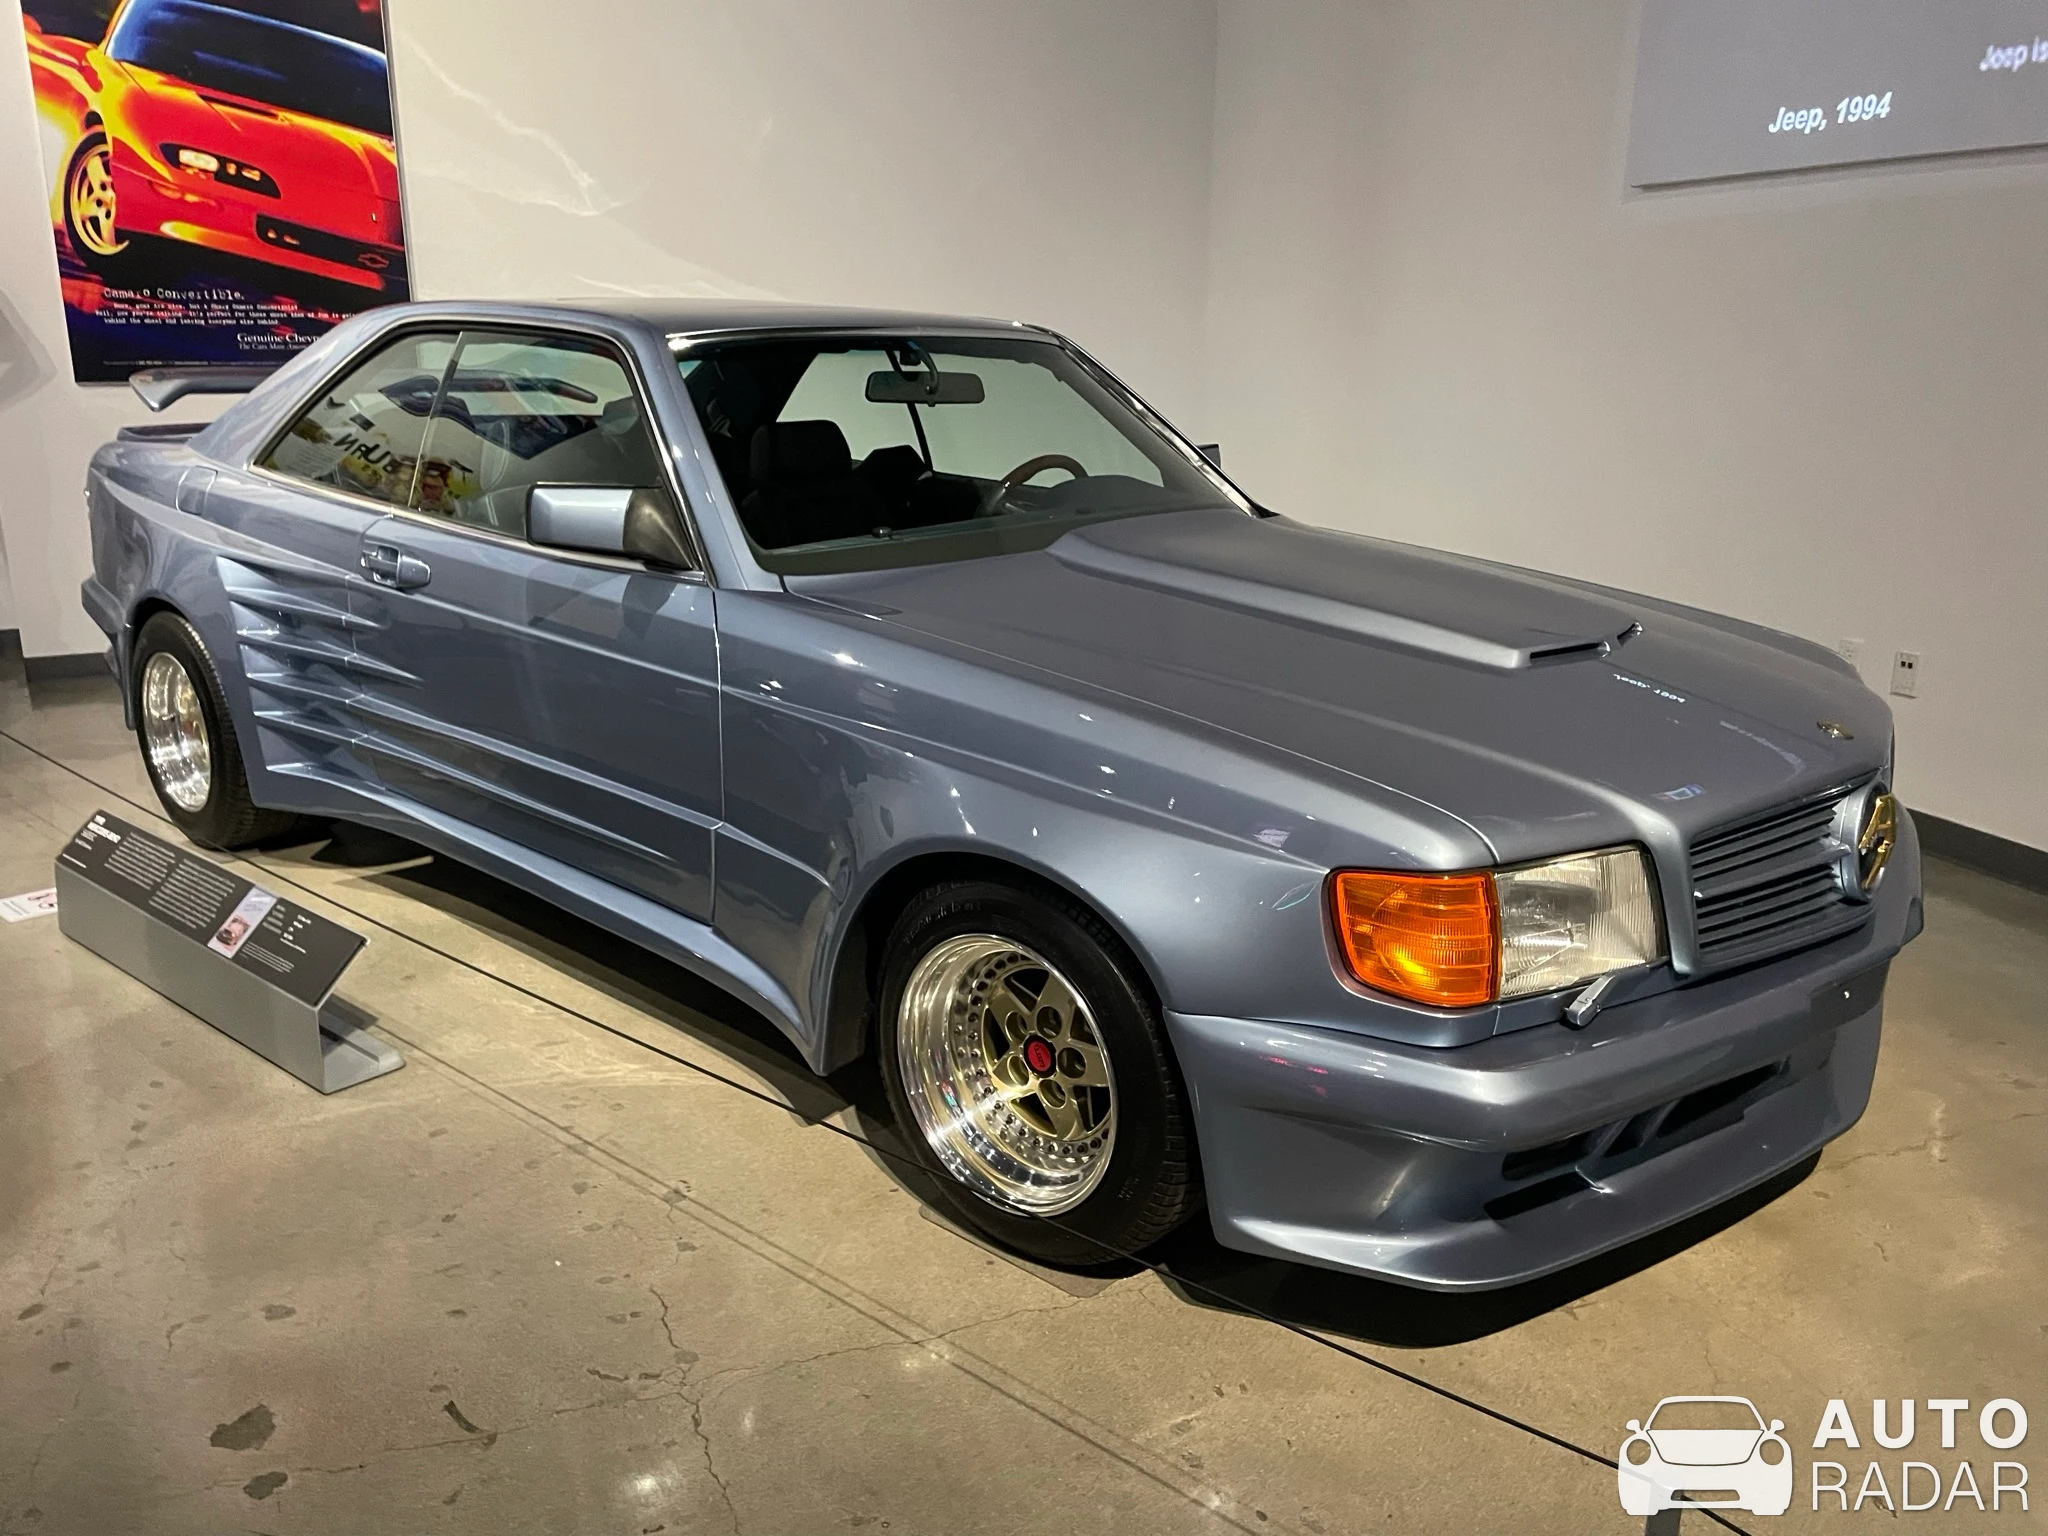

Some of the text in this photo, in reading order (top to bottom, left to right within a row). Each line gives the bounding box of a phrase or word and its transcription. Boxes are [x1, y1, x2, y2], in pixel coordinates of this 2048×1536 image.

[1979, 44, 2028, 73] Jeep
[1768, 91, 1892, 134] Jeep, 1994
[103, 287, 245, 300] Camaro Convertible.
[237, 332, 318, 343] Genuine Chevr
